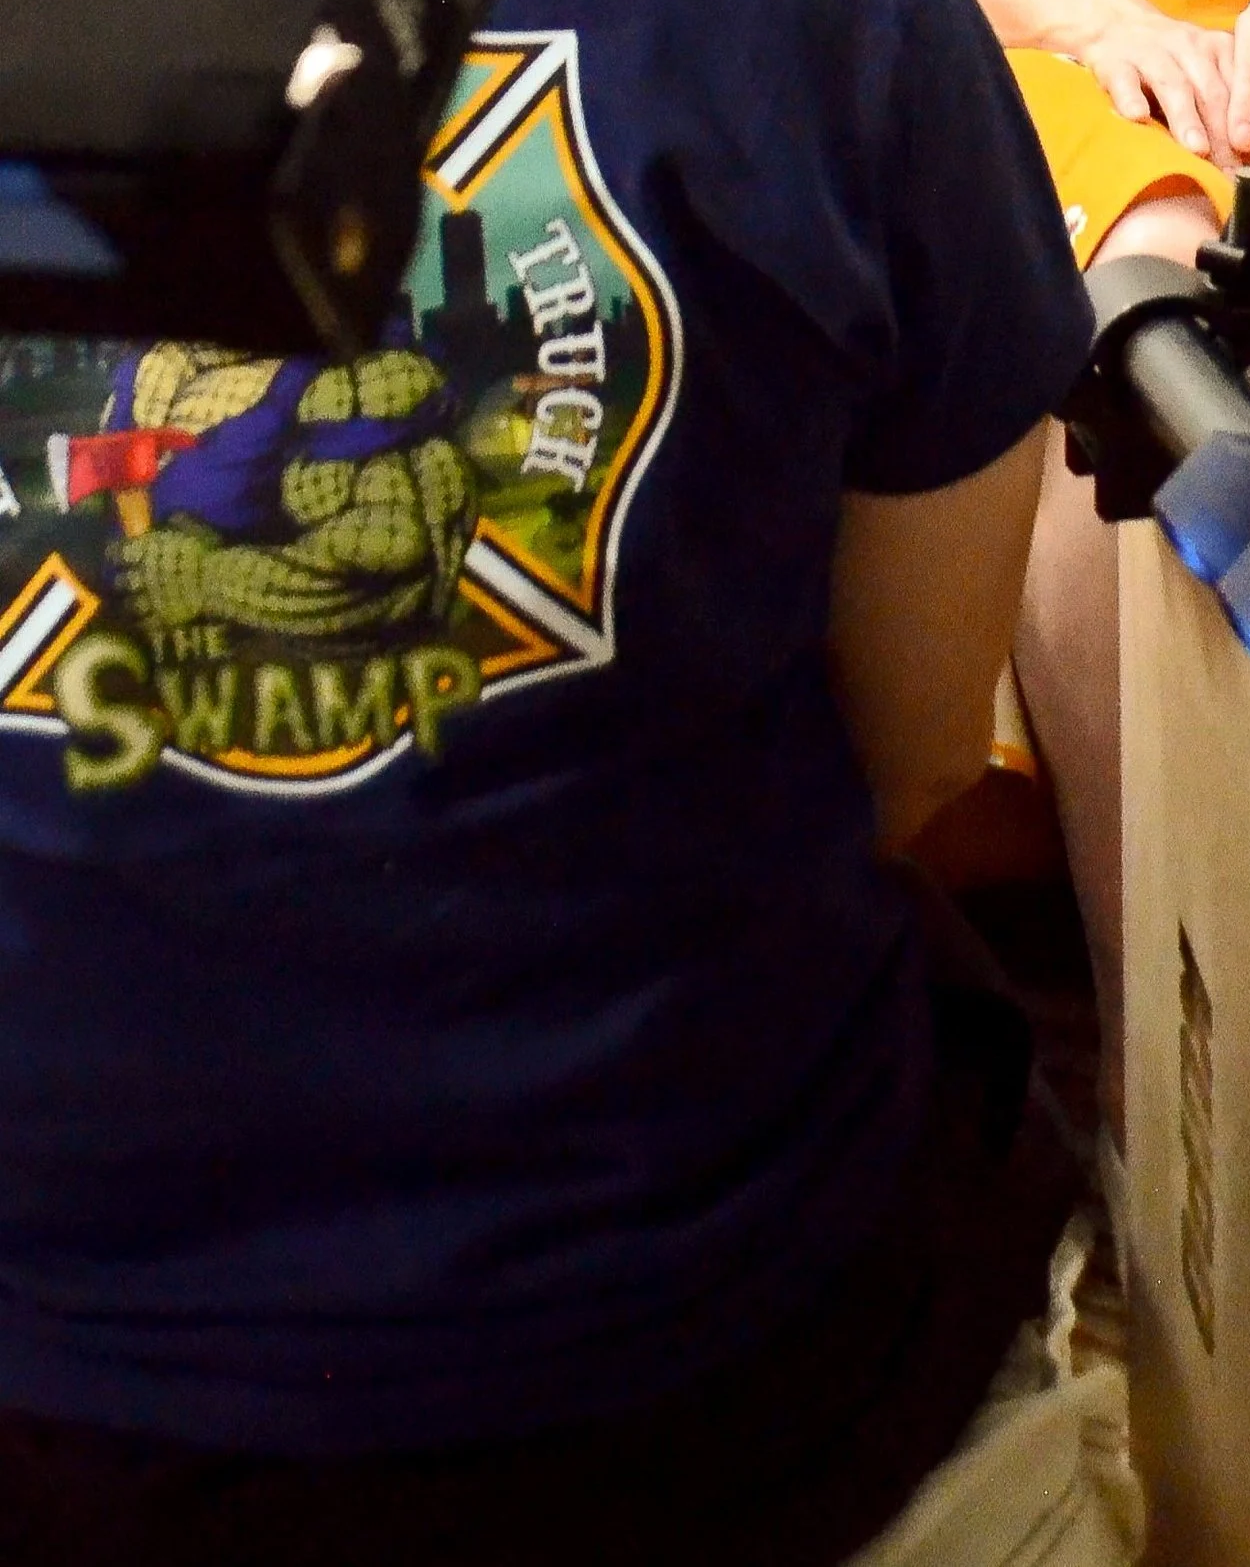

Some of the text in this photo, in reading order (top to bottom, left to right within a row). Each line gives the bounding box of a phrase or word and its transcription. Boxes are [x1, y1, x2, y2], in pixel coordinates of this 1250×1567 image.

[508, 218, 606, 493] TRUCK
[53, 633, 481, 794] SWAMP
[147, 624, 230, 663] THE
